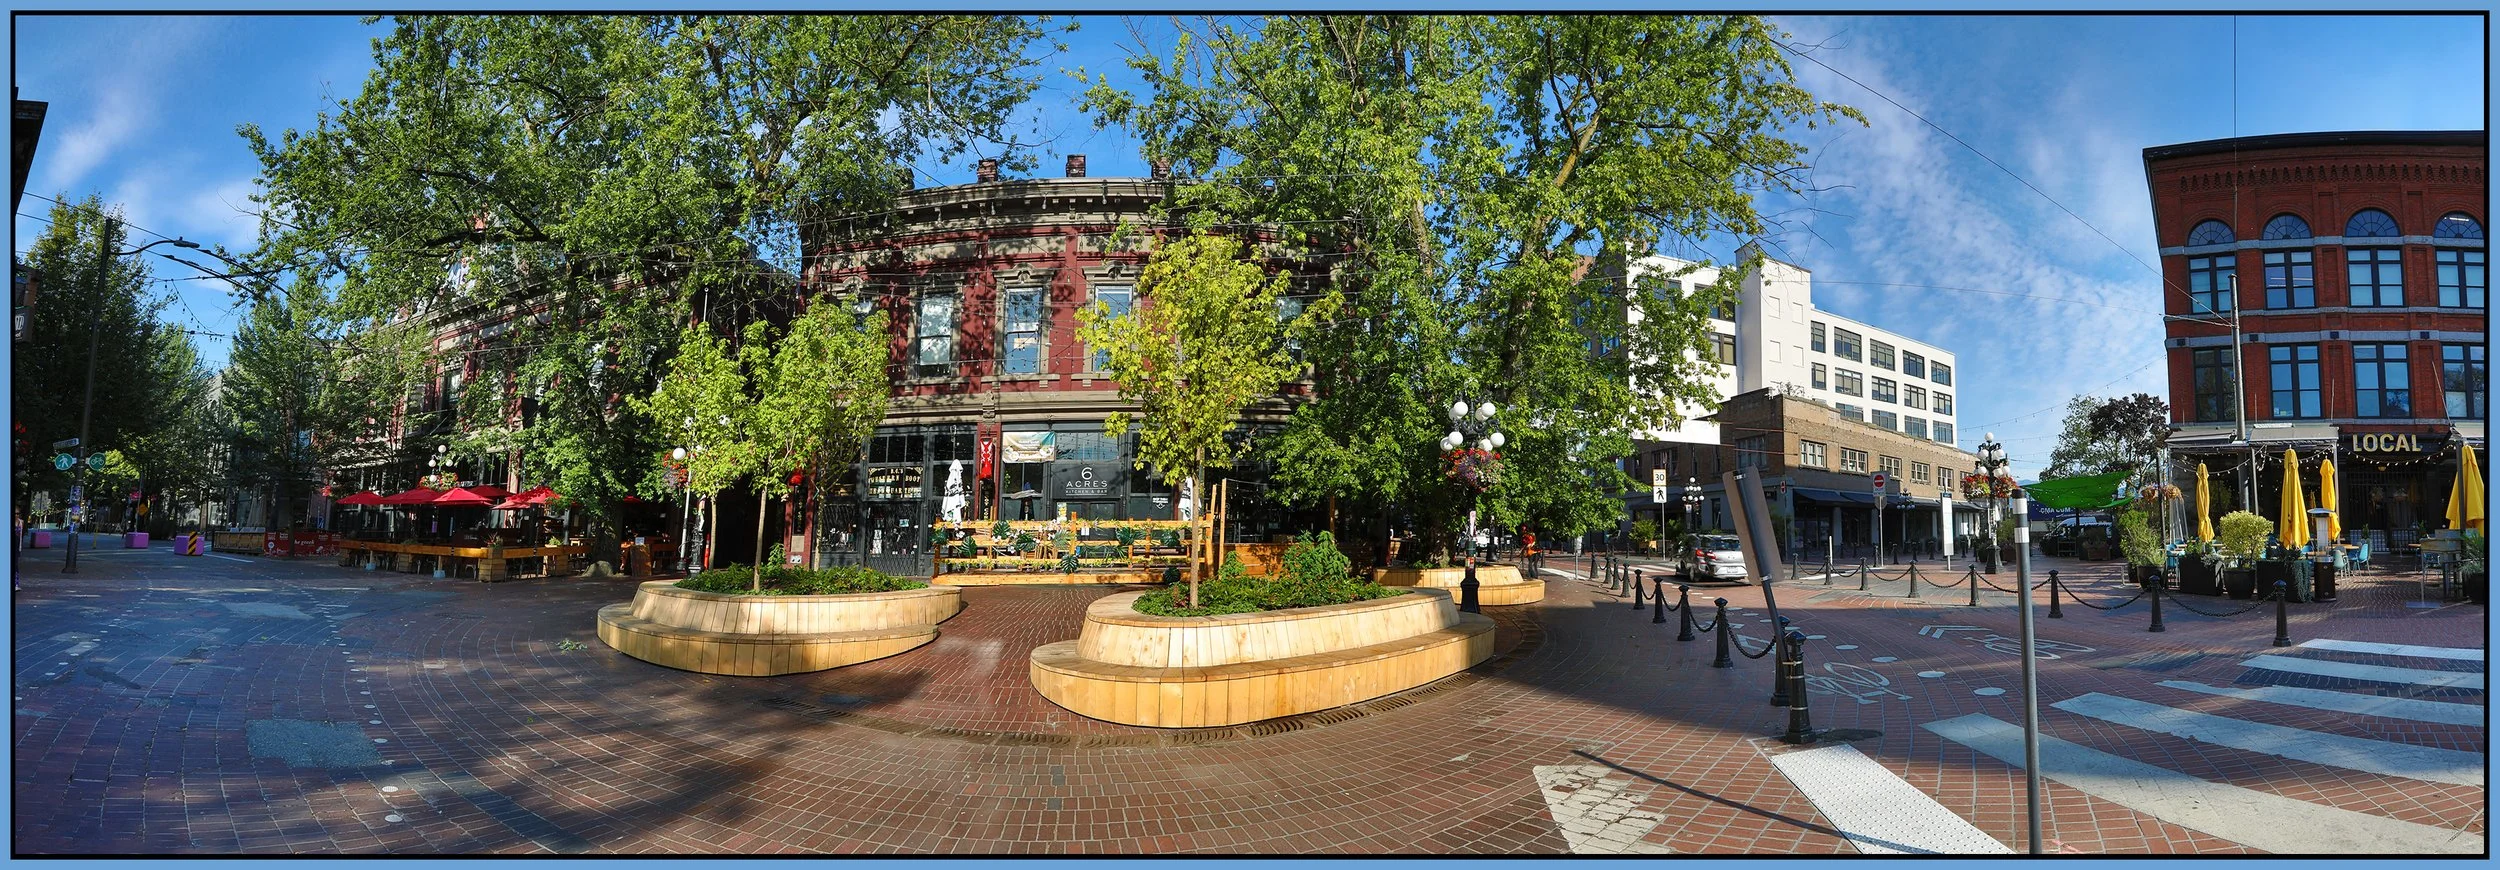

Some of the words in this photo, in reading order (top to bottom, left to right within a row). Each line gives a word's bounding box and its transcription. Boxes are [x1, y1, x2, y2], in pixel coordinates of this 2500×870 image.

[2352, 433, 2422, 453] LOCAL
[1081, 467, 1093, 480] 6
[1655, 473, 1665, 481] 30
[1066, 480, 1108, 488] ACRES
